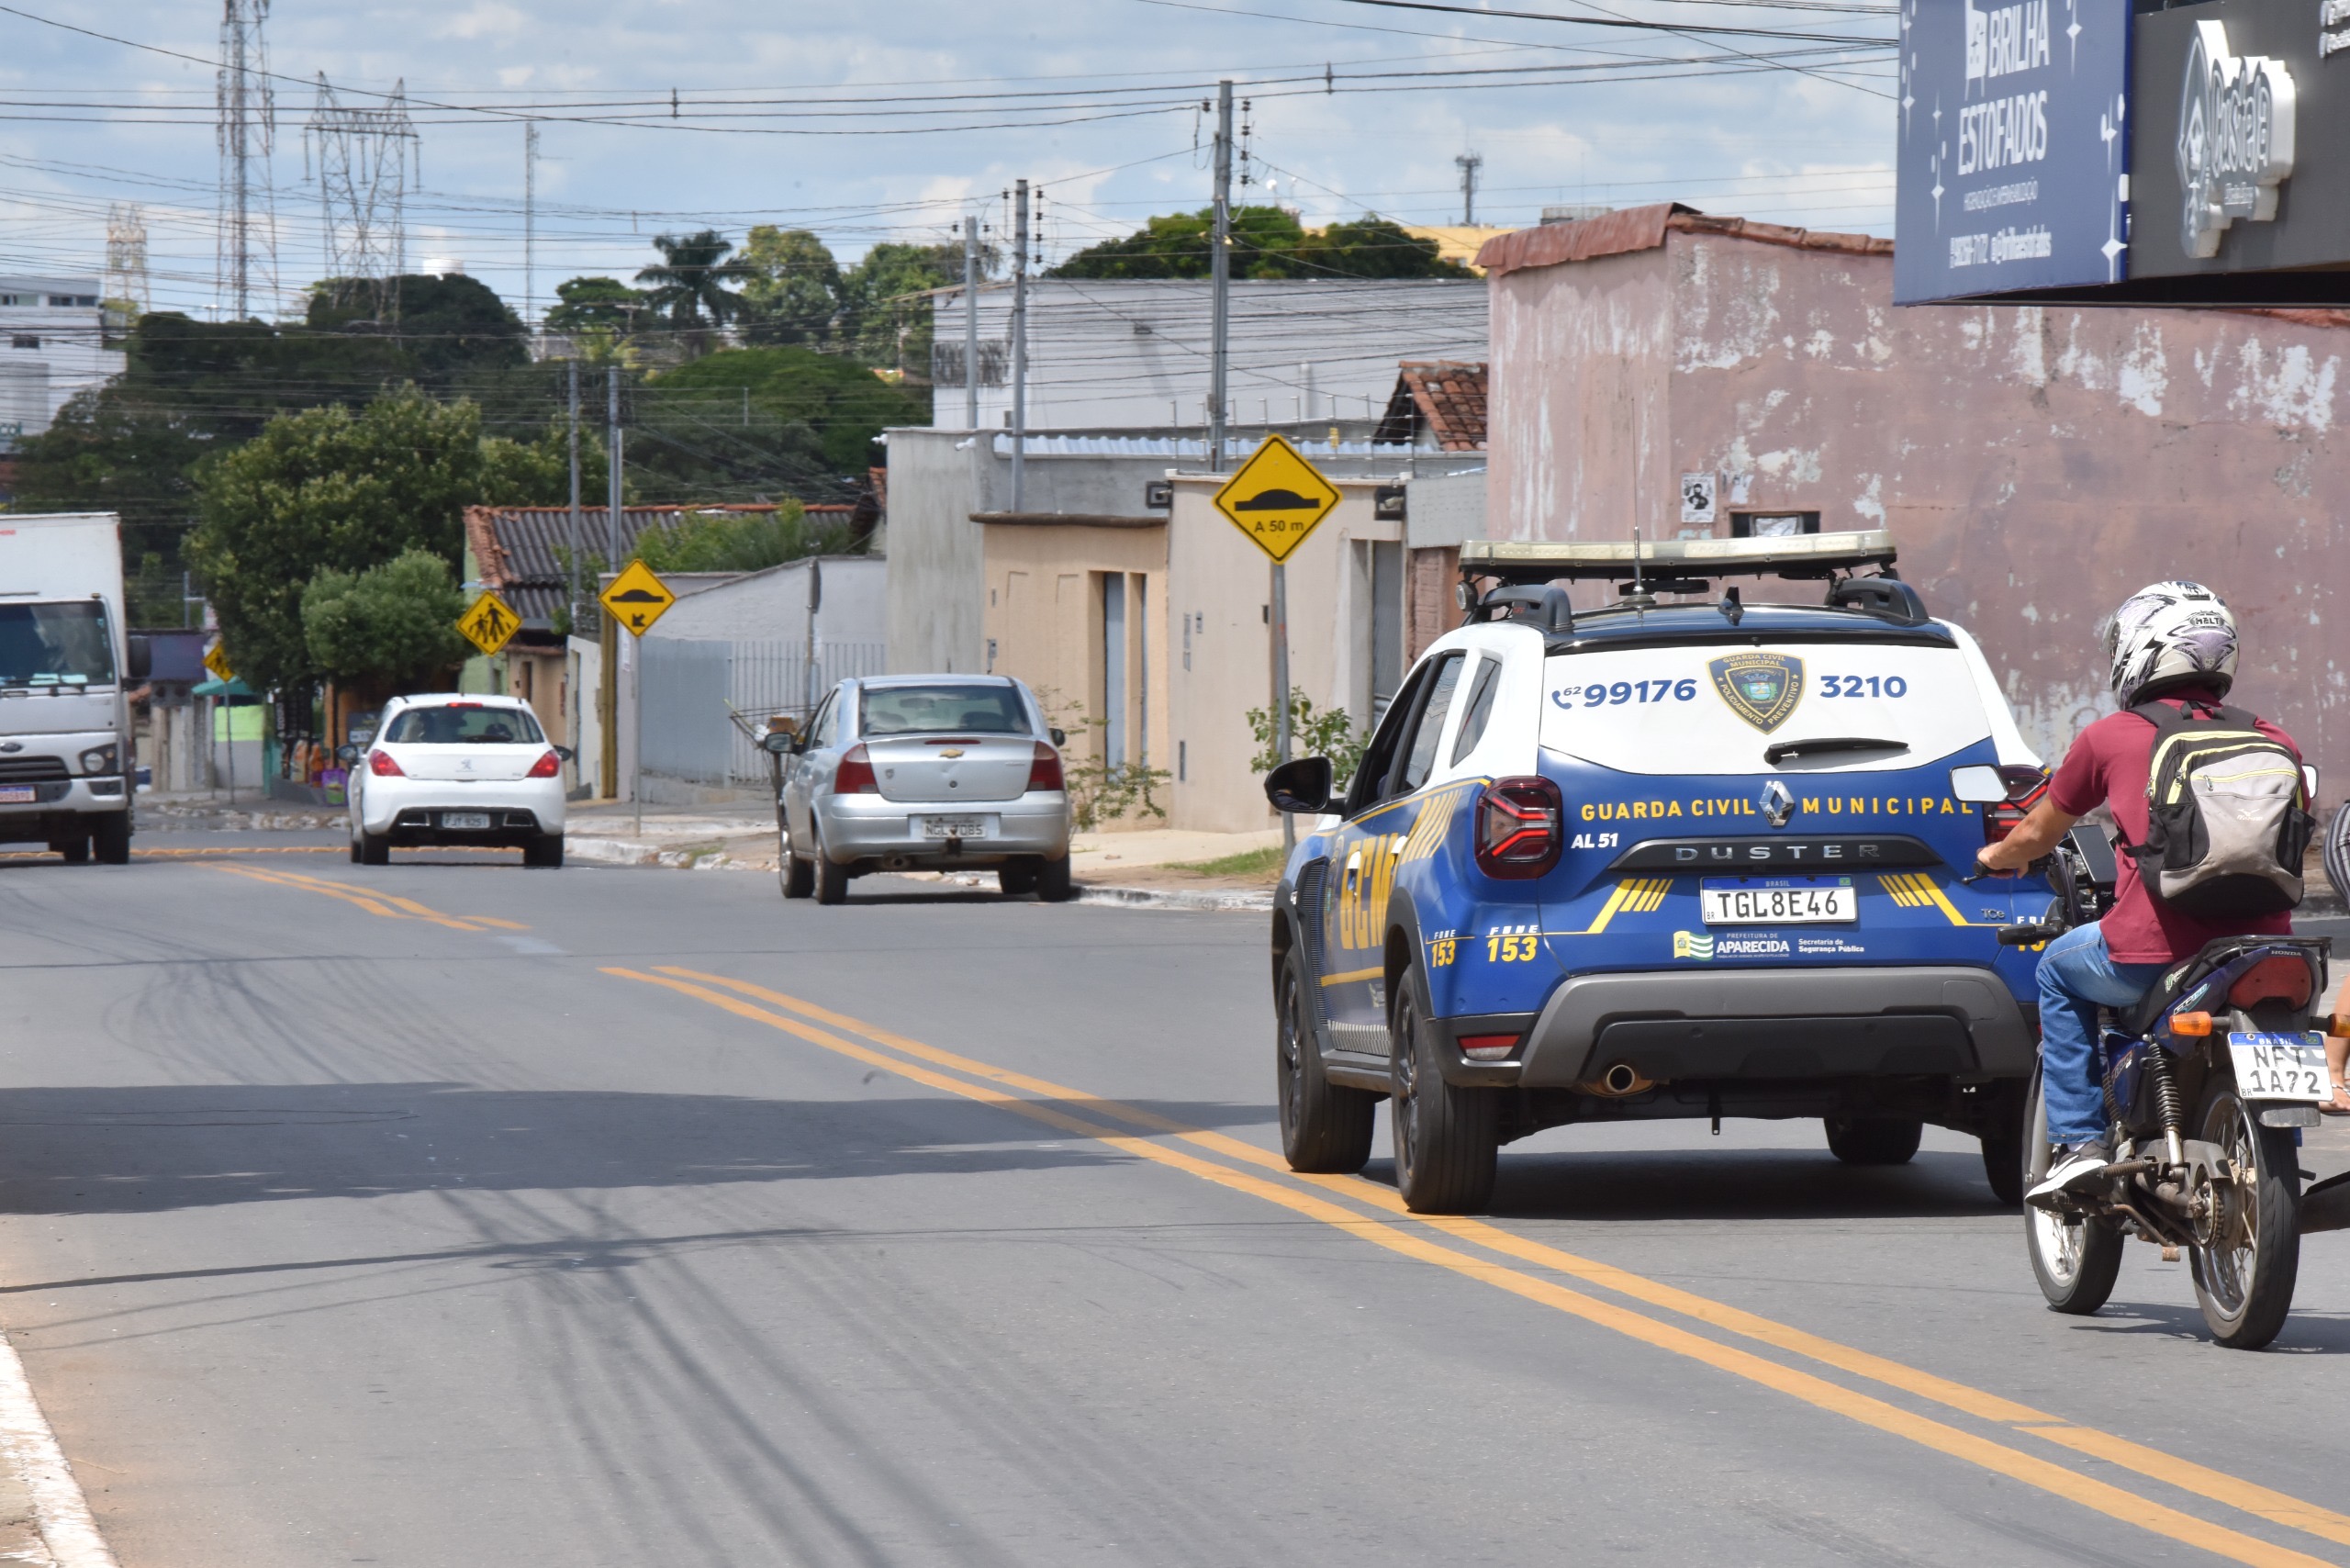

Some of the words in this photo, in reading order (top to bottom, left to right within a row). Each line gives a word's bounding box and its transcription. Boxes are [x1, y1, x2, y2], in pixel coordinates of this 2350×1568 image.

[1988, 0, 2050, 78] BRILHA
[1957, 90, 2048, 175] ESTOFADOS
[1254, 521, 1265, 532] A
[1269, 520, 1286, 532] 50
[1290, 521, 1304, 532] m
[1723, 654, 1762, 663] GUARDA
[1729, 660, 1781, 668] MUNICIPAL
[1563, 686, 1582, 697] 62
[1583, 678, 1697, 708] 99176
[1819, 675, 1908, 699] 3210
[1720, 684, 1763, 724] POLICIAMENTO
[1767, 681, 1799, 724] PREVENTIVO
[1581, 800, 1683, 822] GUARDA
[1691, 798, 1756, 816] CIVIL
[1802, 797, 1974, 814] MUNICIPAL
[1571, 834, 1595, 849] AL
[1598, 833, 1618, 848] 51
[1675, 844, 1880, 861] DUSTER
[1707, 912, 1716, 920] BR
[1718, 890, 1839, 919] TGL8E46
[1981, 908, 2005, 919] TCe
[1490, 924, 1539, 935] FONE
[1432, 940, 1456, 968] 153
[1487, 936, 1538, 962] 153
[1717, 941, 1790, 953] APARECIDA
[2250, 1070, 2321, 1094] 1A72
